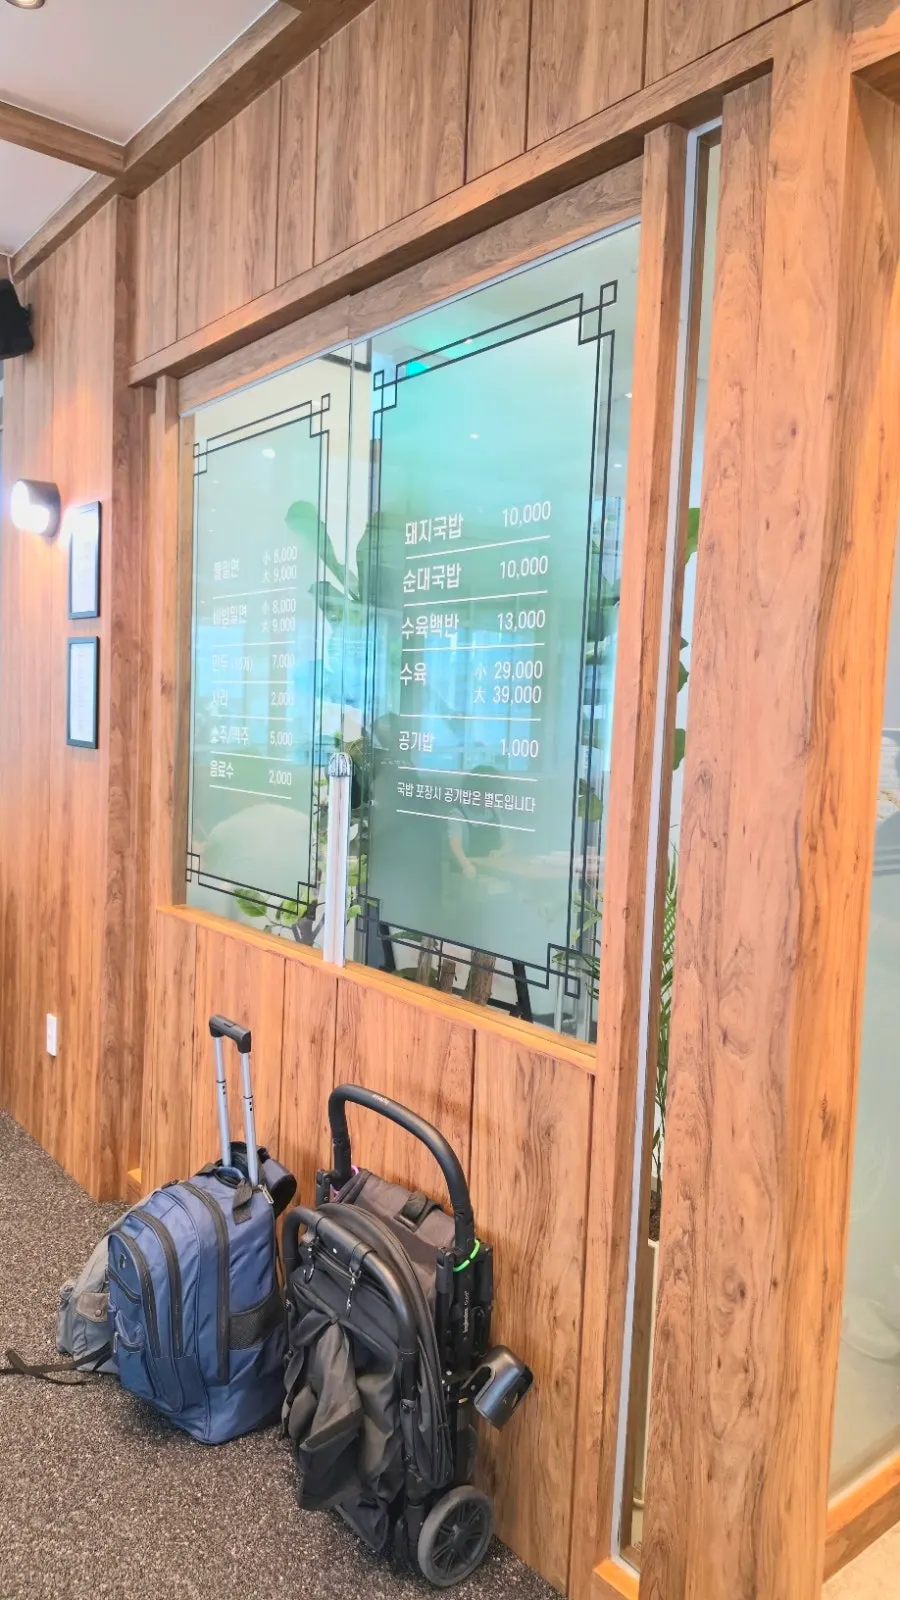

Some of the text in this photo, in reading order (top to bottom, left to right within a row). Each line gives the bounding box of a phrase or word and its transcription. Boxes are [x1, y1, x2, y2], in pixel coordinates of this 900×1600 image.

[405, 500, 551, 545] 돼지국밥 10,000
[403, 555, 548, 593] 순대국밥 10,000
[401, 609, 545, 641] 수육백반 13,000
[272, 653, 295, 670] 7,000
[400, 662, 427, 686] 수육
[494, 660, 543, 681] 29,000
[473, 685, 541, 705] 大 39,000
[270, 730, 293, 746] 5,000
[398, 731, 539, 758] 공기밥 1,000
[210, 760, 292, 786] 음료수 2,000
[396, 781, 536, 813] 국밥 포장시 공기밥은 별도입니다
